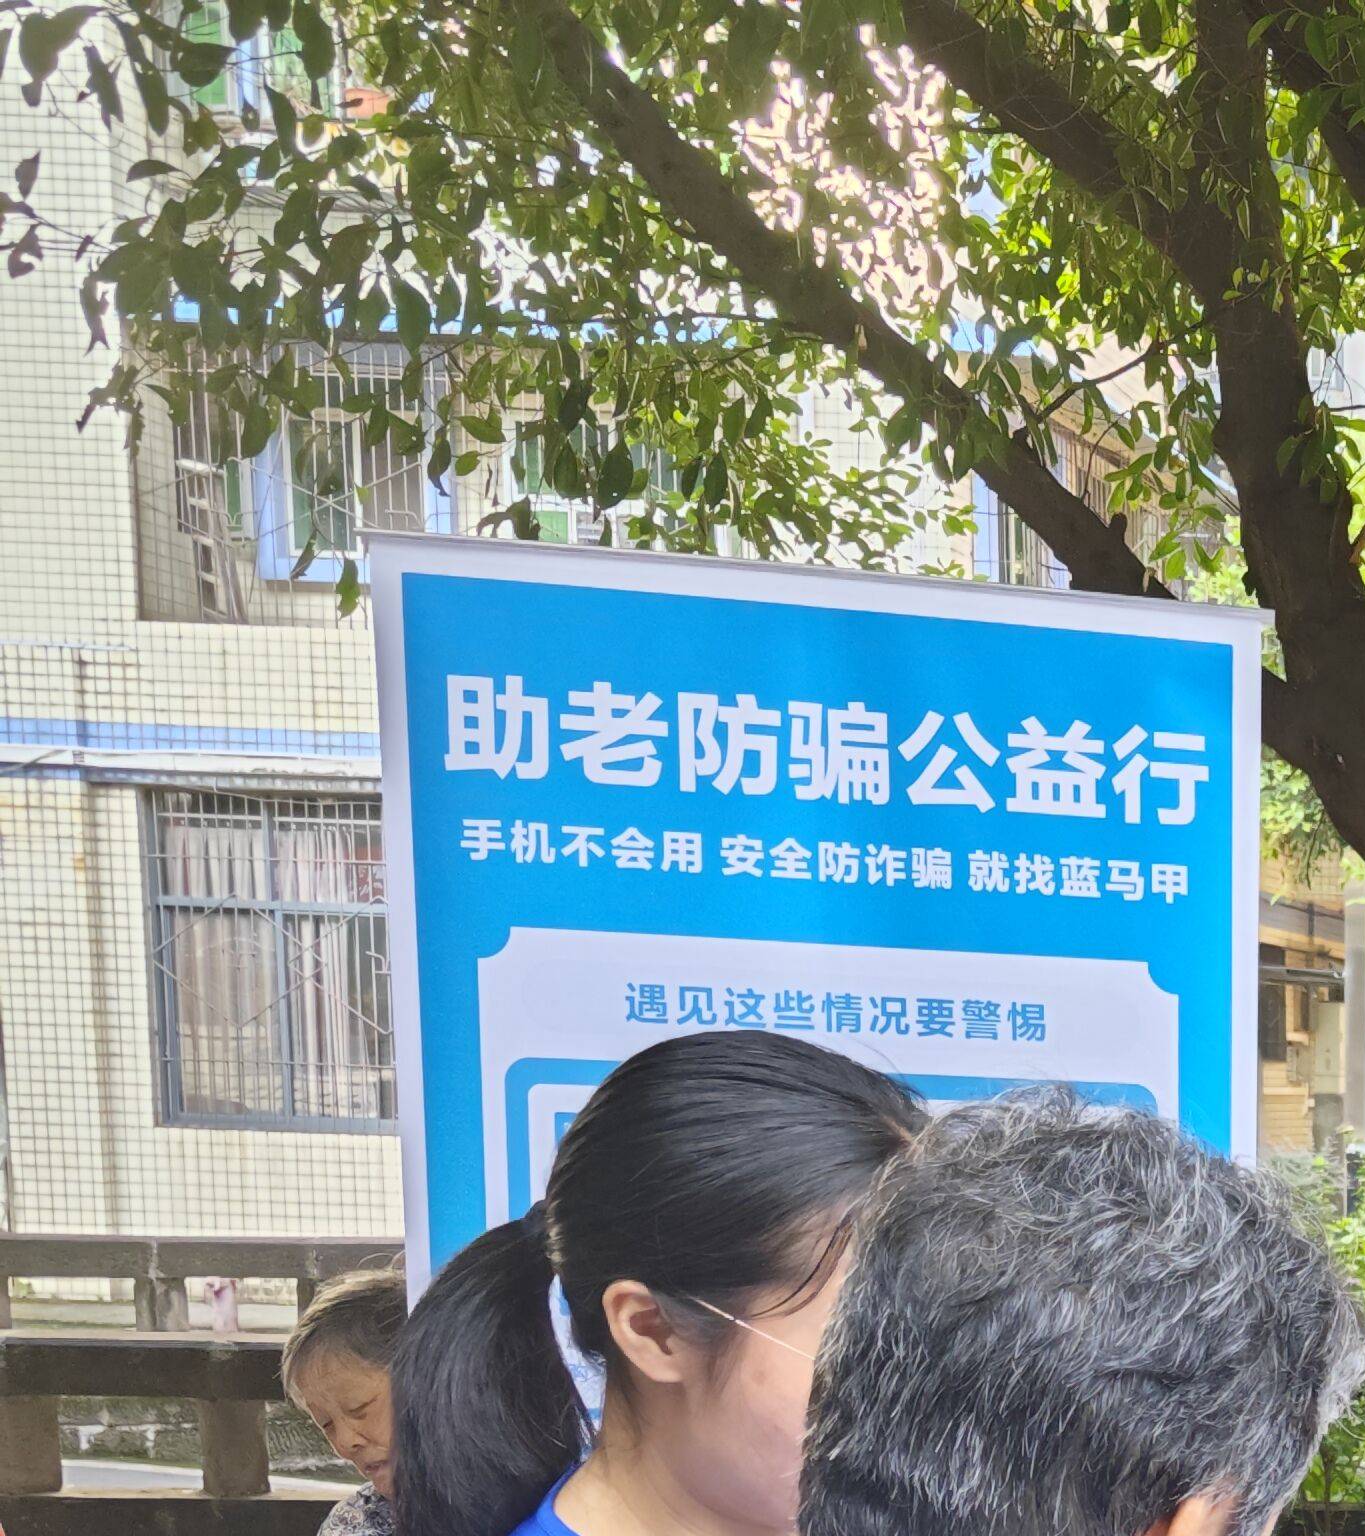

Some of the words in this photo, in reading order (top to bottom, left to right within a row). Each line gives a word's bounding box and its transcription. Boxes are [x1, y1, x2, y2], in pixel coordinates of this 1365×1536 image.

[444, 673, 1210, 826] 助老防骗公益行
[459, 817, 704, 874] 手机不会用
[720, 835, 953, 890] 安全防诈骗
[967, 849, 1190, 904] 就找蓝马甲
[623, 981, 1048, 1043] 遇见这些情况要警惕
